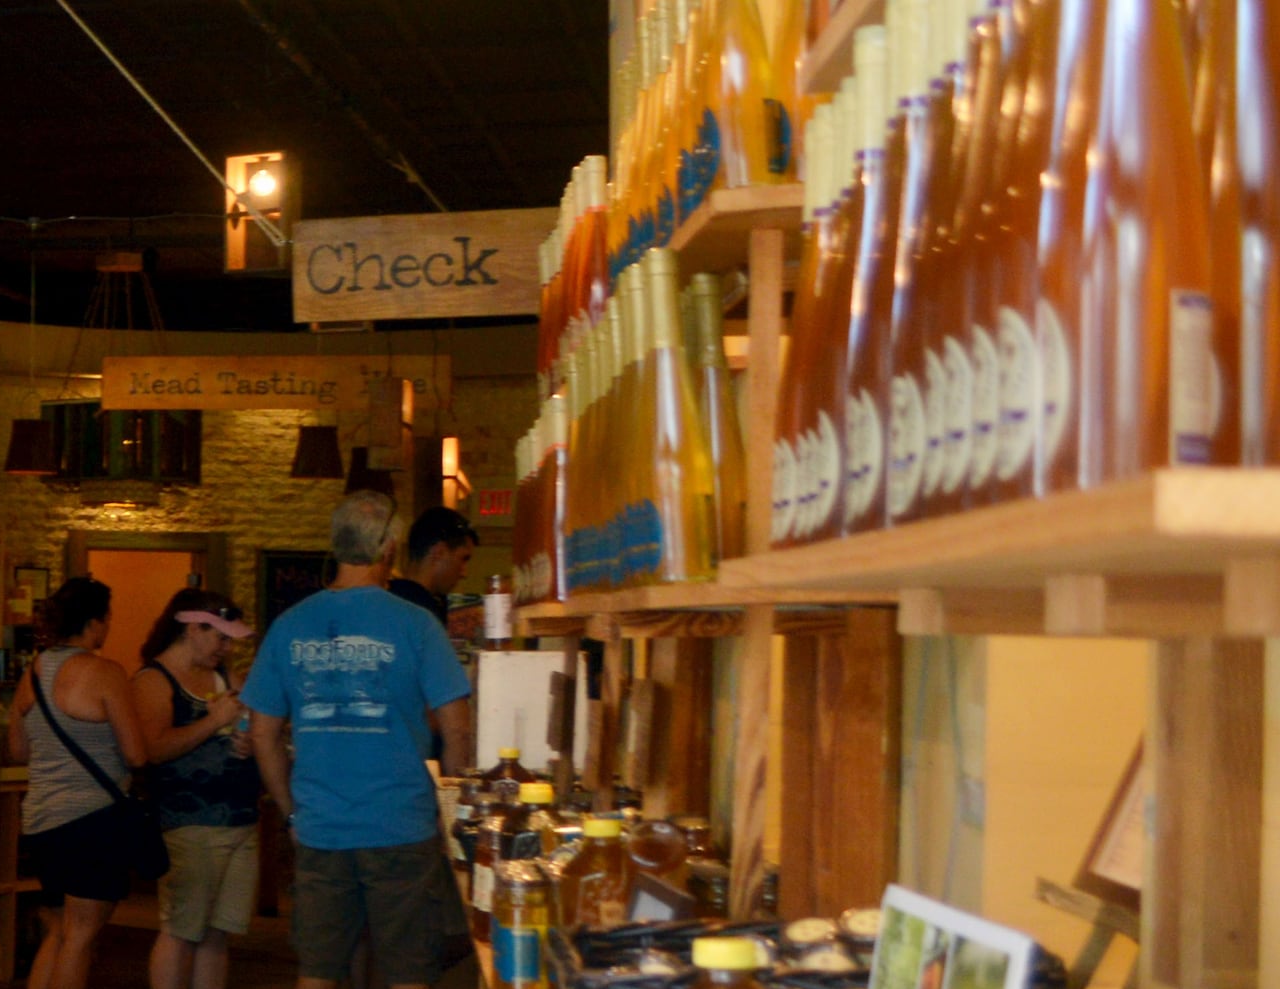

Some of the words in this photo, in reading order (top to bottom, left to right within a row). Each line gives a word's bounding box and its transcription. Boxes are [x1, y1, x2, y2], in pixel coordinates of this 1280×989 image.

[307, 236, 499, 295] Check
[129, 371, 203, 396] Mead
[216, 371, 338, 405] Tasting
